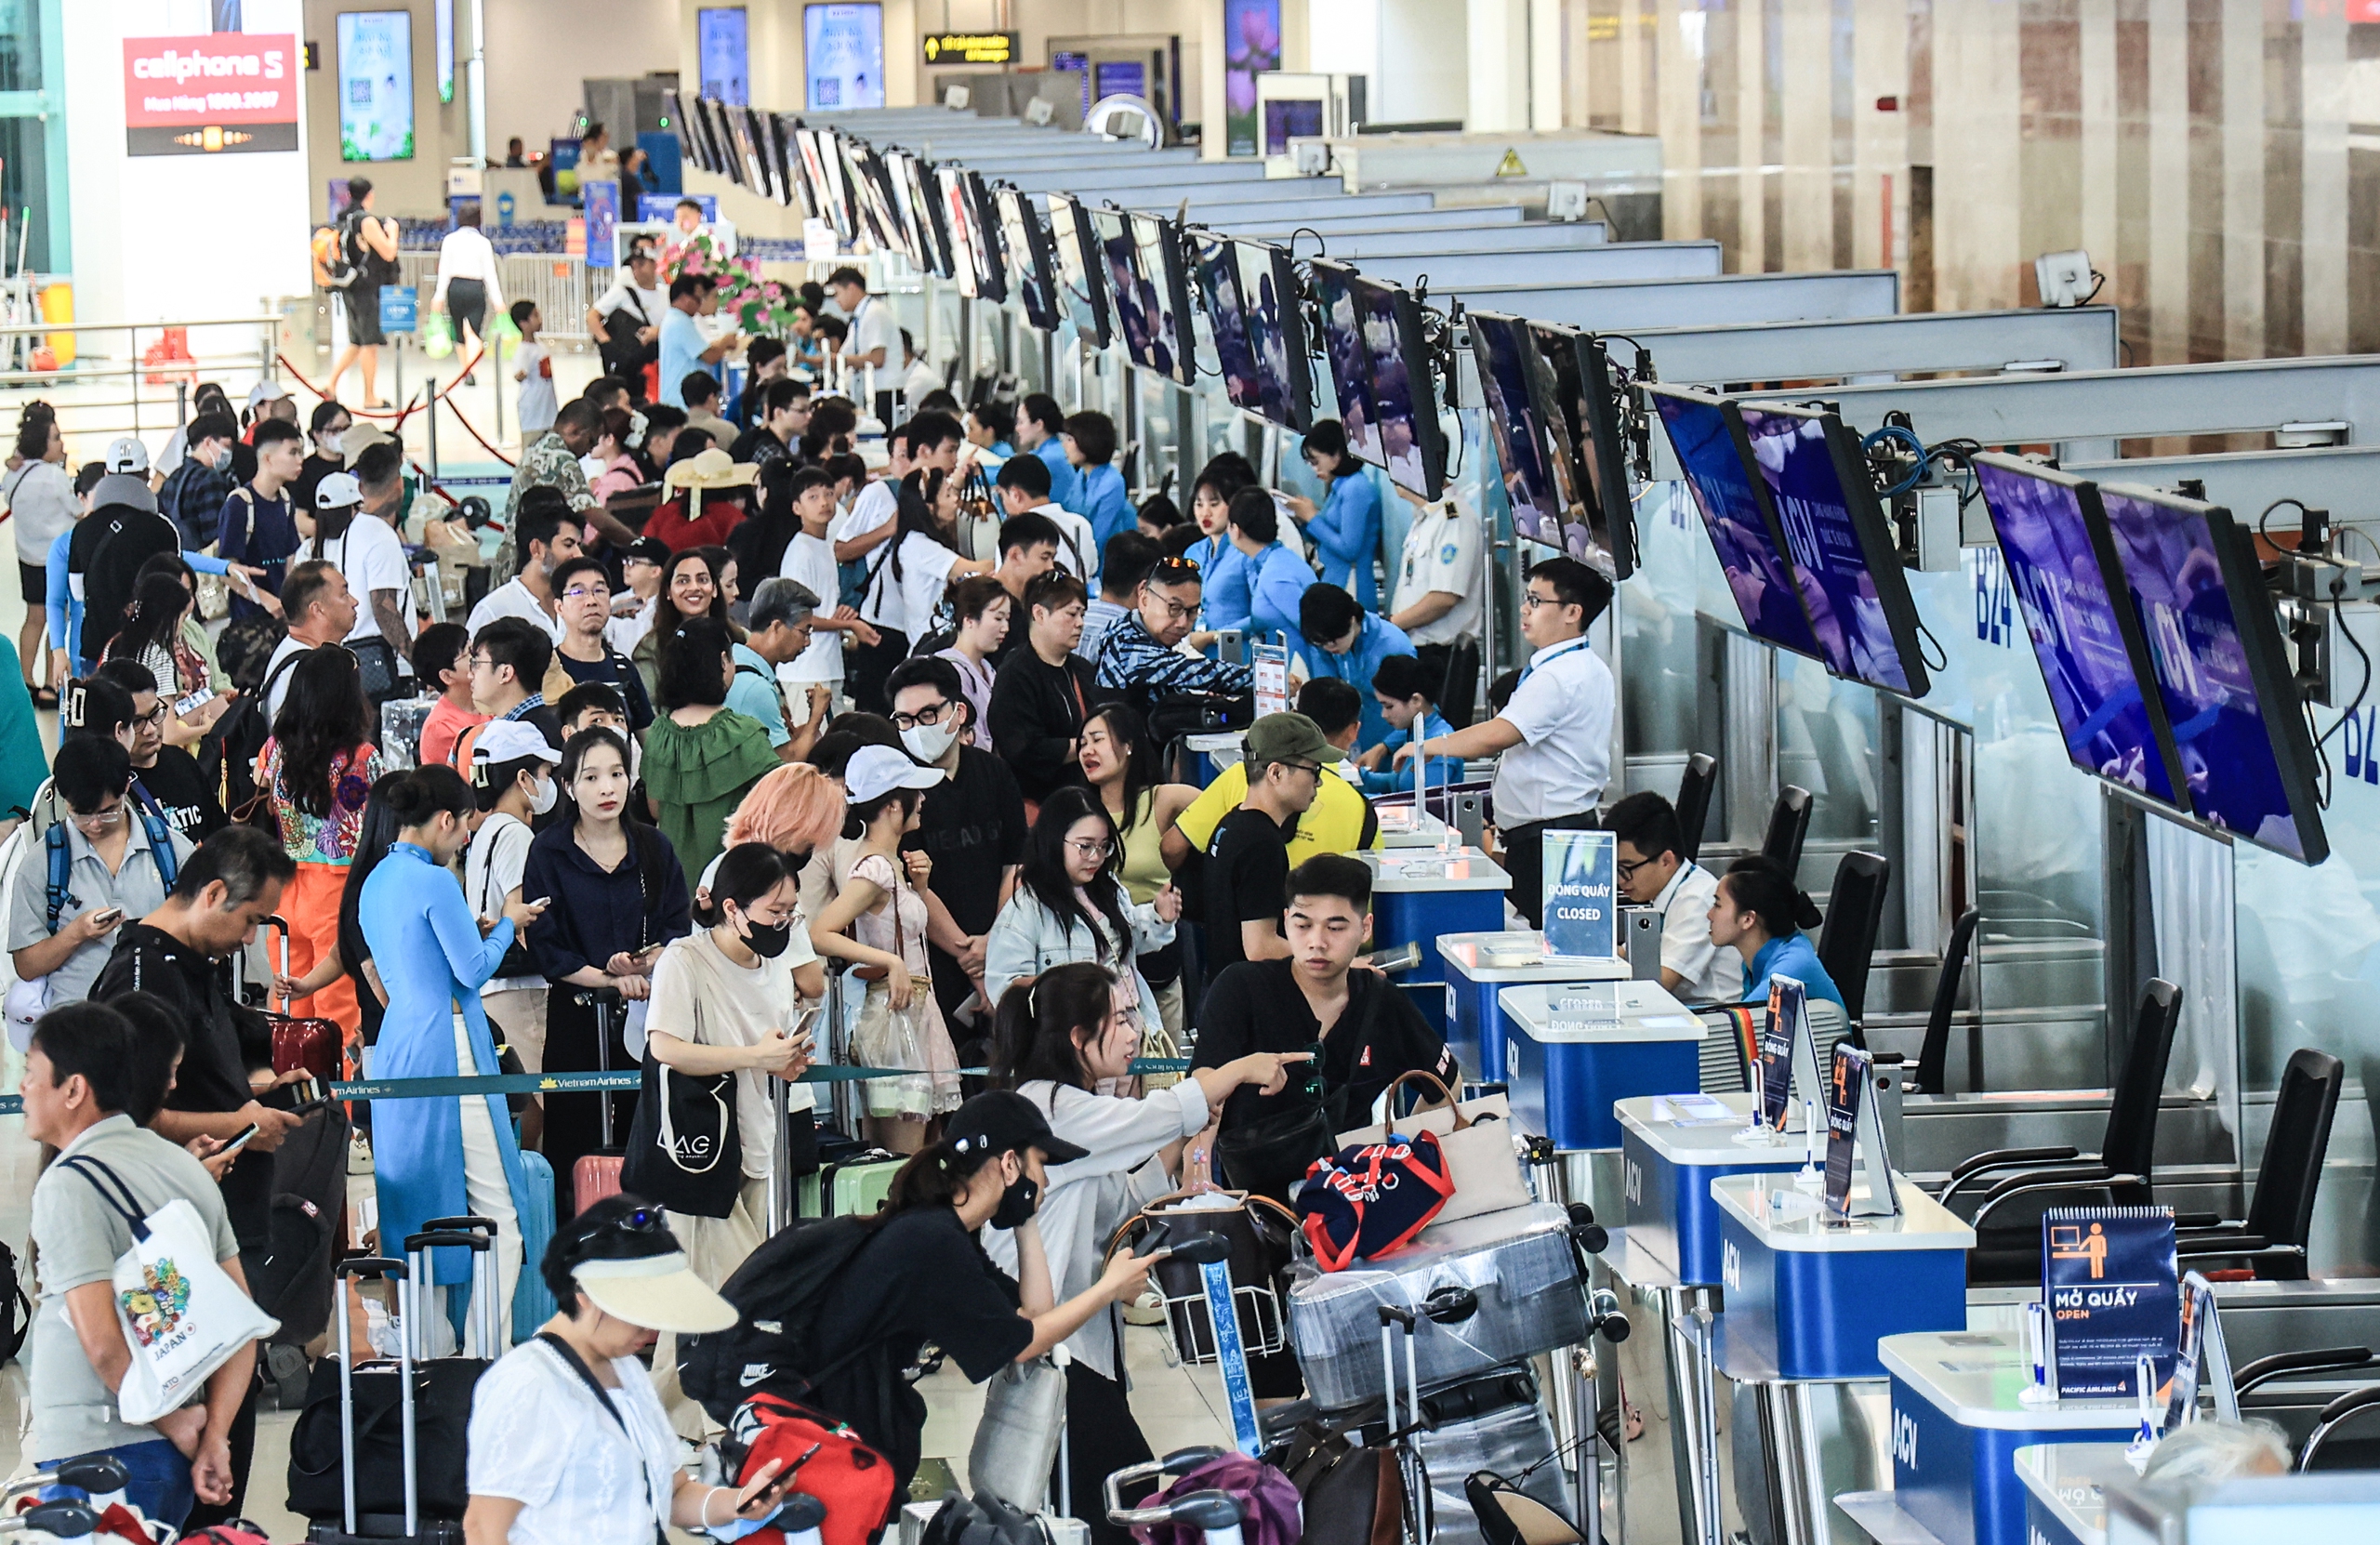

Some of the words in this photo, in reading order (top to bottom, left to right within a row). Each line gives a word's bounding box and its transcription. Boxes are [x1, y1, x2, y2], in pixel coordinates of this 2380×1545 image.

[1775, 495, 1824, 571] ACV
[1976, 547, 2012, 649] B24
[1547, 882, 1580, 897] ĐÓNG
[1556, 906, 1601, 920] CLOSED
[558, 1078, 597, 1088] Vietnam
[596, 1076, 632, 1086] Airlines
[346, 1085, 381, 1095] Airlines
[2055, 1288, 2083, 1308] MỞ
[2056, 1309, 2090, 1320] OPEN
[153, 1330, 188, 1361] JAPAN
[744, 1363, 770, 1378] NIKE
[1893, 1407, 1918, 1471] ACV
